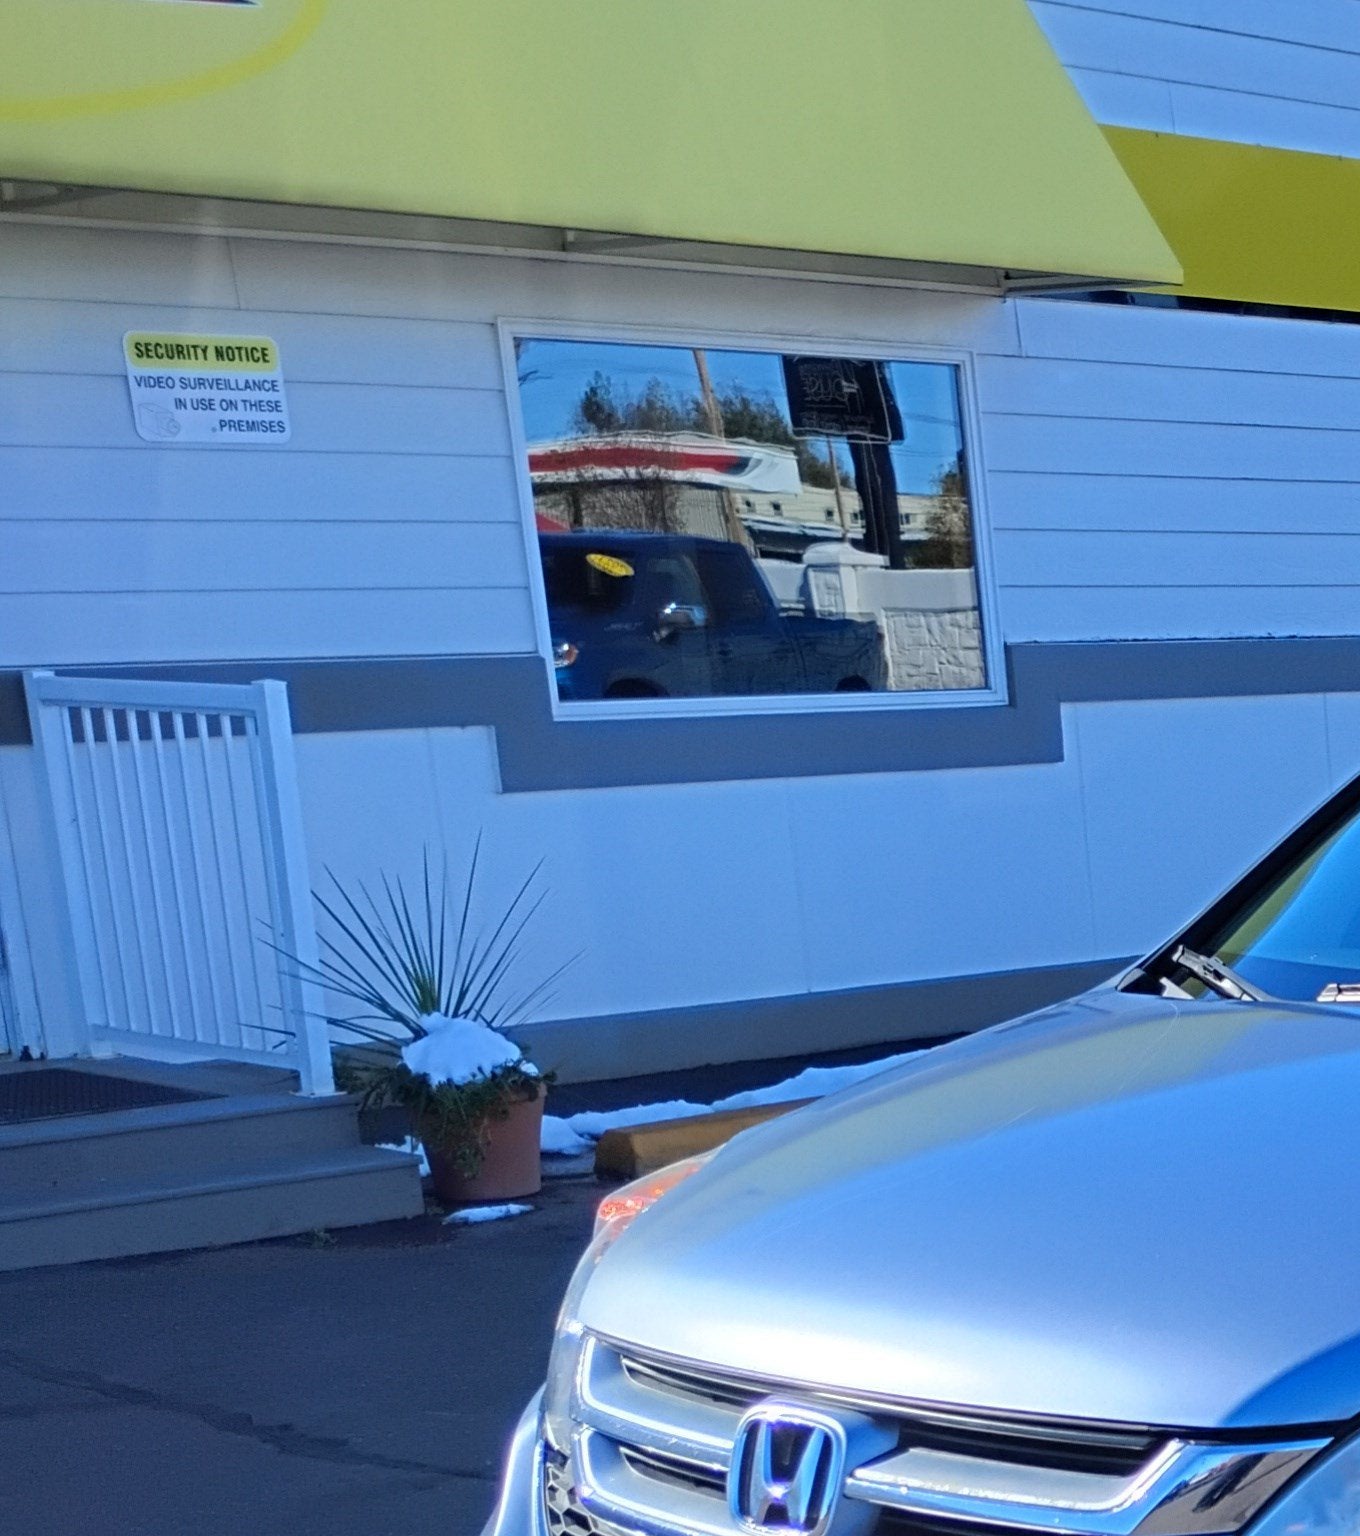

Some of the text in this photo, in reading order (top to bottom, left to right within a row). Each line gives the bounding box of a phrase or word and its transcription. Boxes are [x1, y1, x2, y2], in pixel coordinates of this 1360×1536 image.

[134, 341, 271, 364] SECURITY NOTICE
[133, 375, 280, 392] VIDEO SURVEILLANCE
[174, 397, 283, 413] IN USE ON THESE
[218, 419, 286, 434] PREMISES
